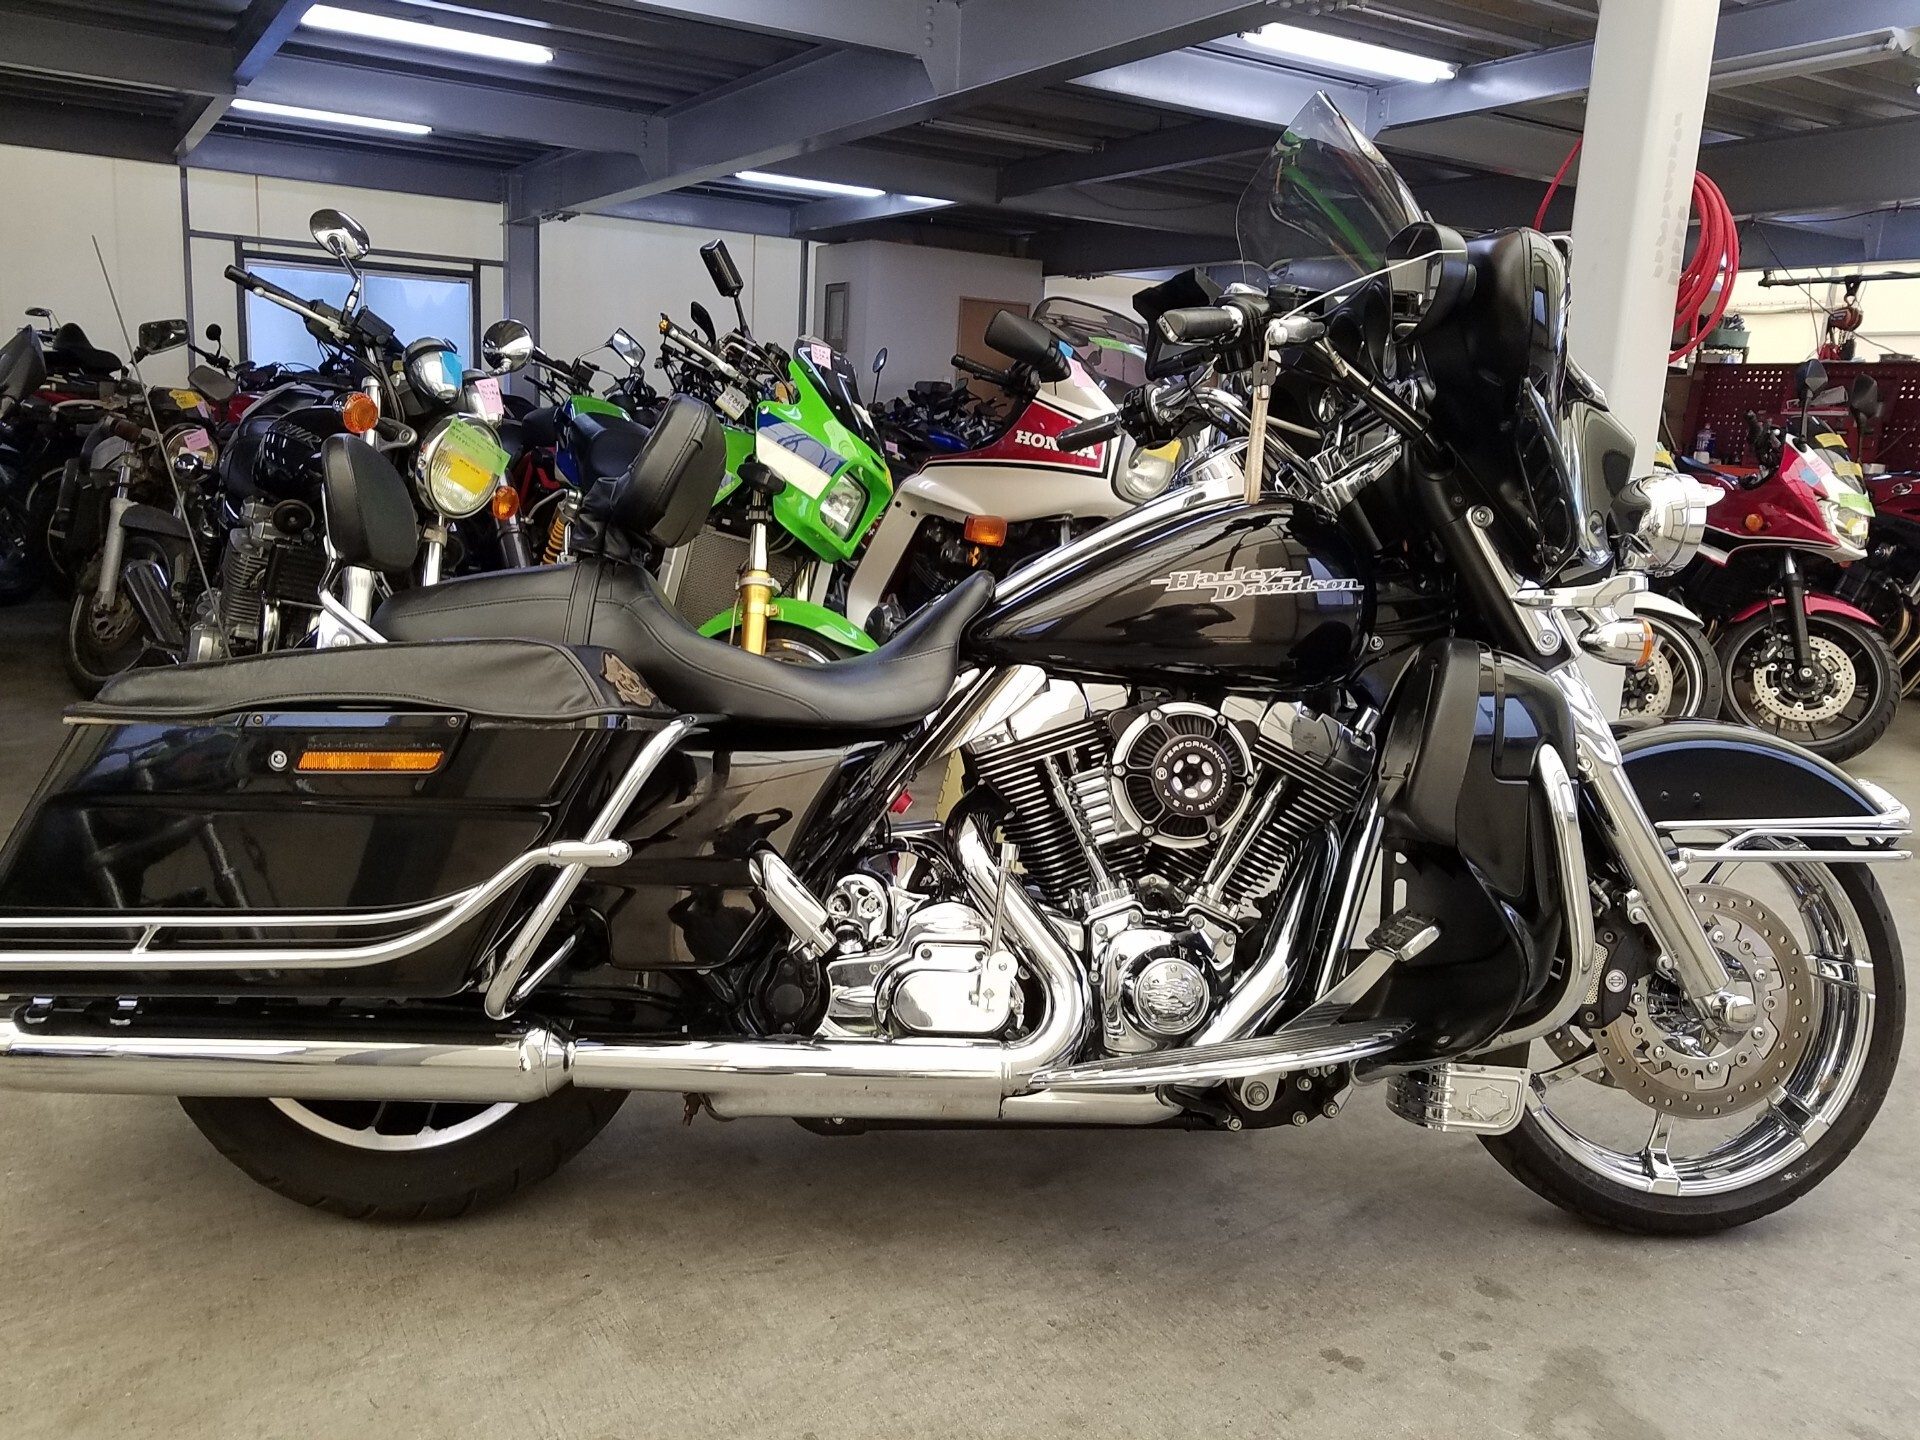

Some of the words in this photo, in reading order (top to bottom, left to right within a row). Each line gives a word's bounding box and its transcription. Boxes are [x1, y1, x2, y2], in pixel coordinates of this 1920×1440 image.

[1014, 430, 1098, 460] HONA
[1160, 566, 1292, 592] Harley
[1211, 575, 1365, 602] Davidson
[1162, 741, 1227, 771] PERFORMANCE
[1198, 772, 1228, 811] MACHINE
